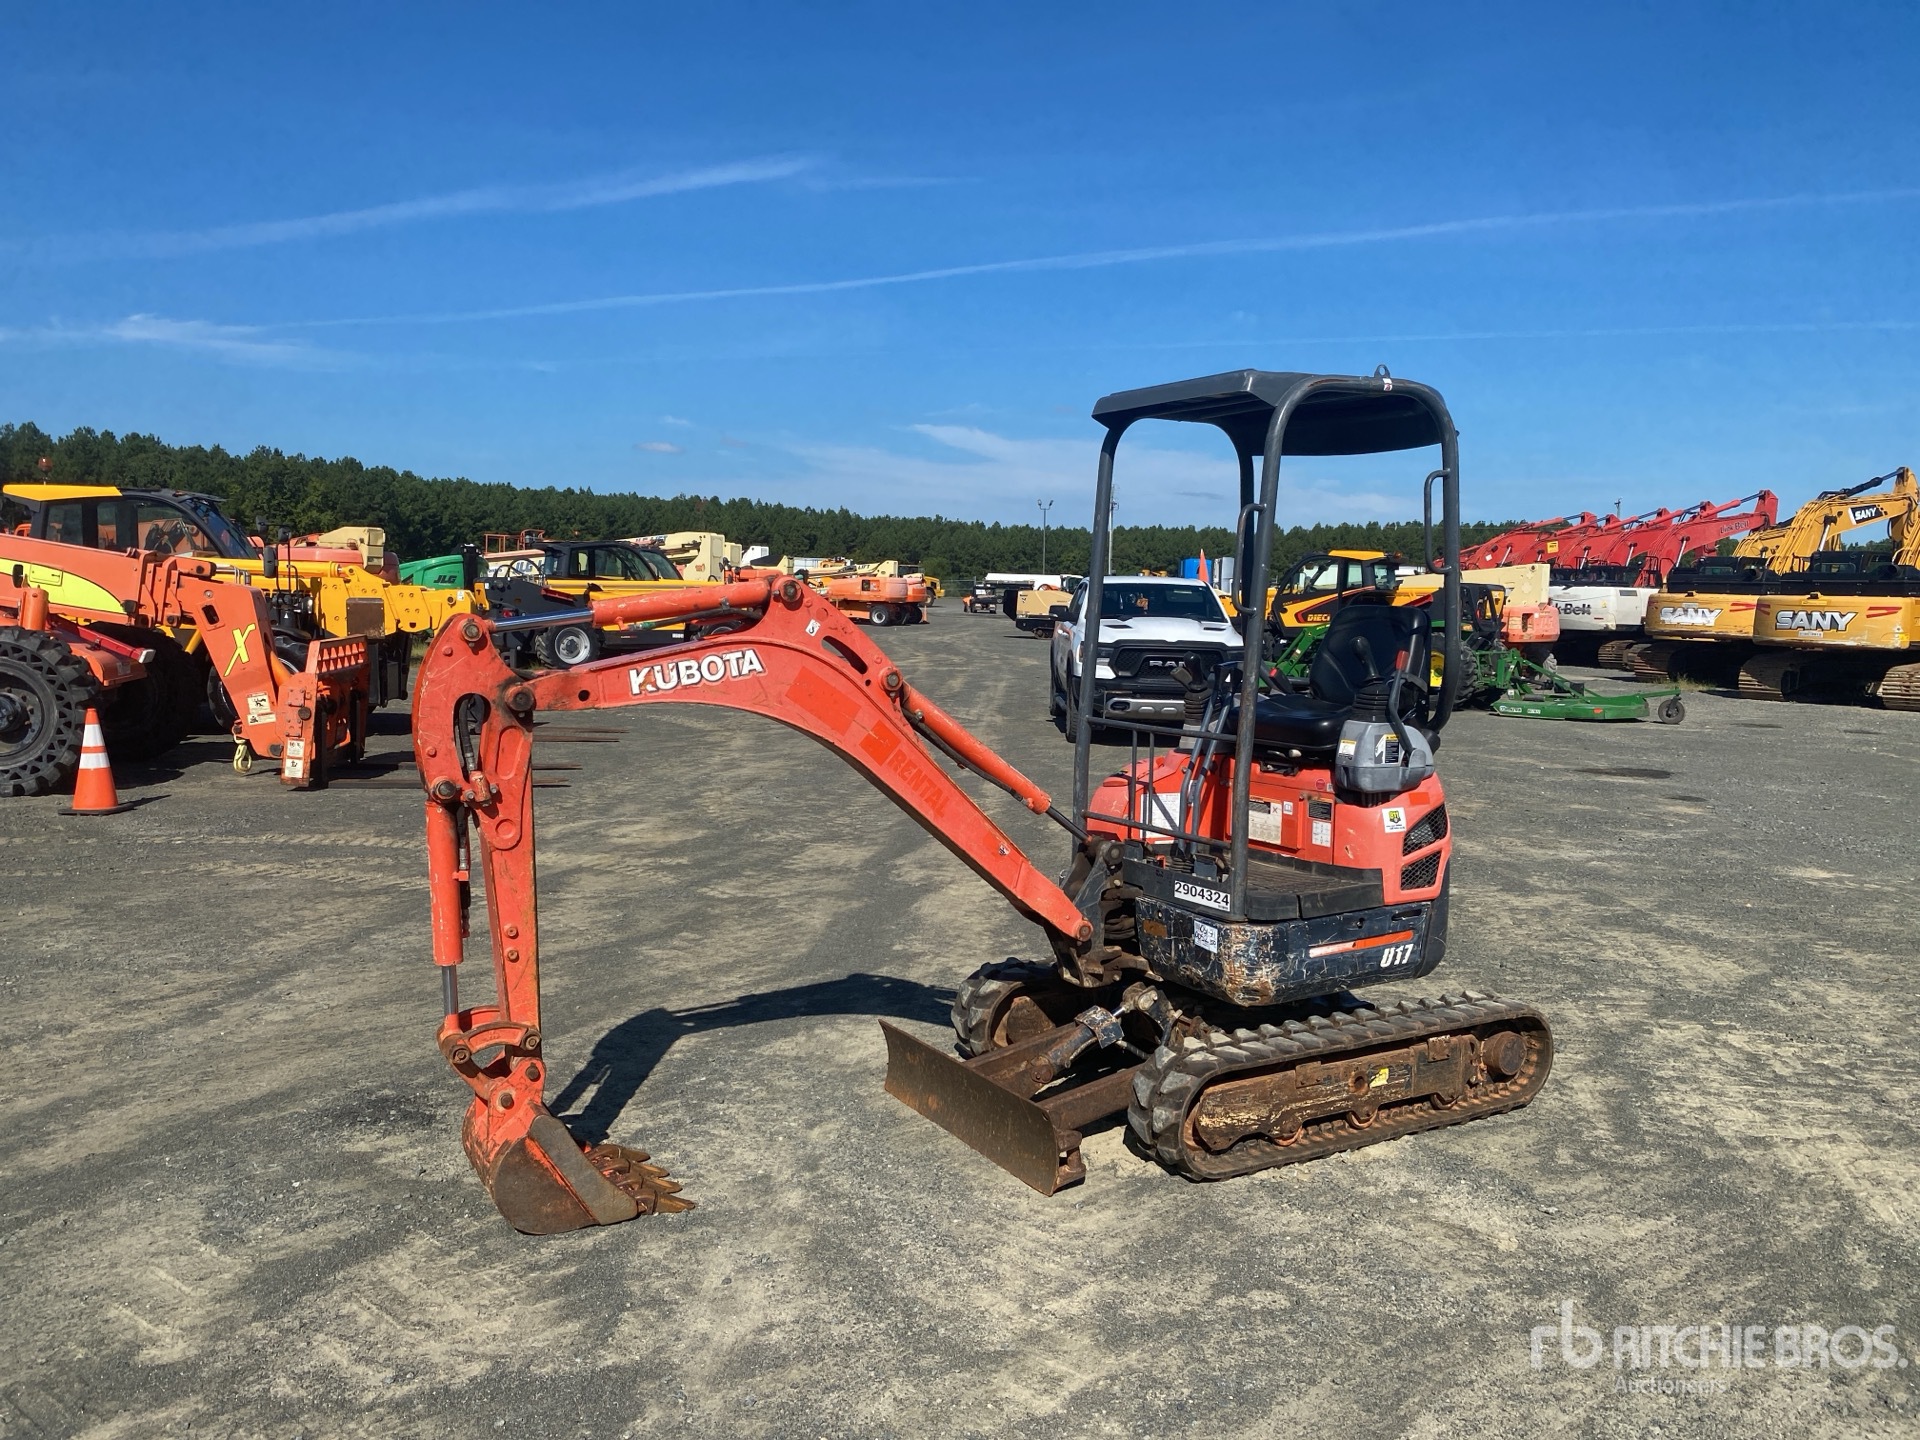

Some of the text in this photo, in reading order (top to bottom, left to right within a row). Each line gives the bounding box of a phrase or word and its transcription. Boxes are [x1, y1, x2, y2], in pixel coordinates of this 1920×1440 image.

[1854, 508, 1877, 521] SANY
[433, 574, 457, 584] JLG
[1660, 606, 1723, 626] SANY
[1775, 610, 1858, 632] SANY
[628, 648, 765, 696] KUBOTA
[886, 748, 951, 819] RENTAL
[1174, 881, 1230, 907] 2904324
[1380, 943, 1415, 968] U17
